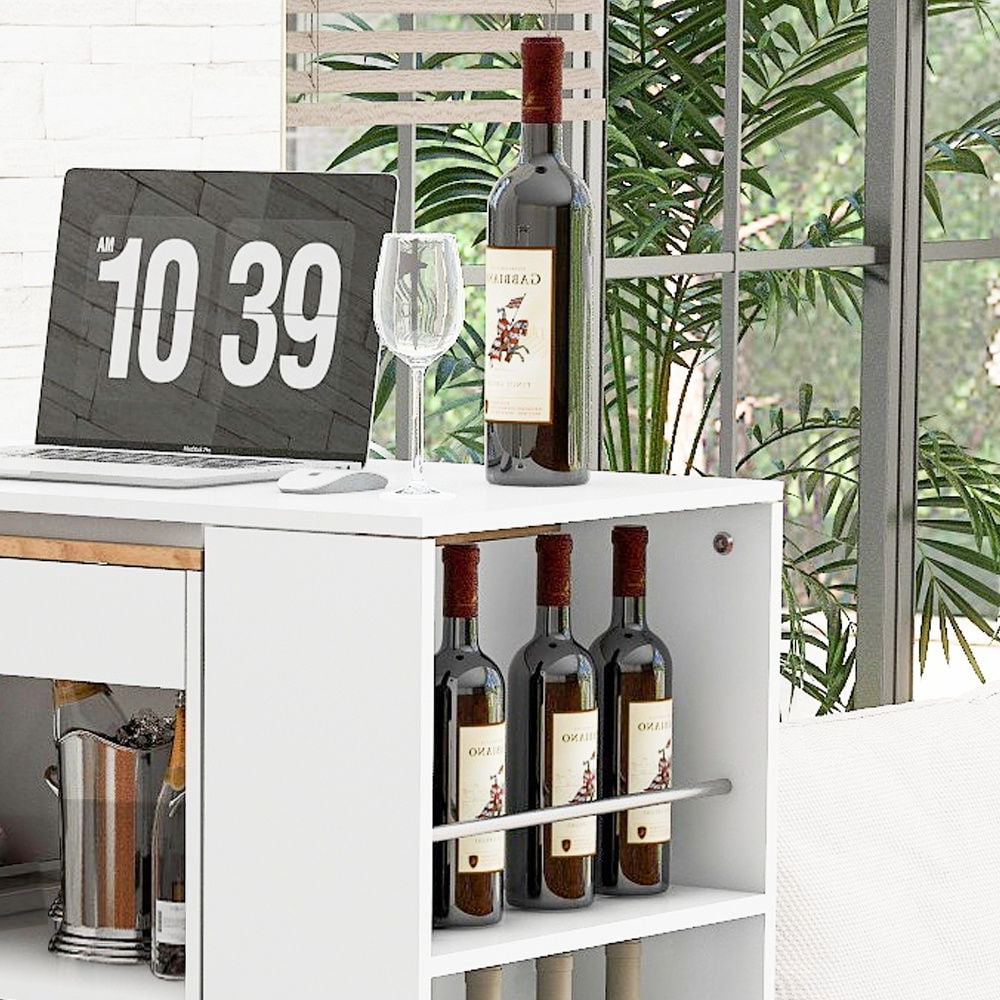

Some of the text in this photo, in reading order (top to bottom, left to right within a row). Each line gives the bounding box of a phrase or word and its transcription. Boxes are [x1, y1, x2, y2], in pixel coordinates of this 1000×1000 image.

[96, 236, 115, 252] AM
[98, 238, 342, 390] 10 39
